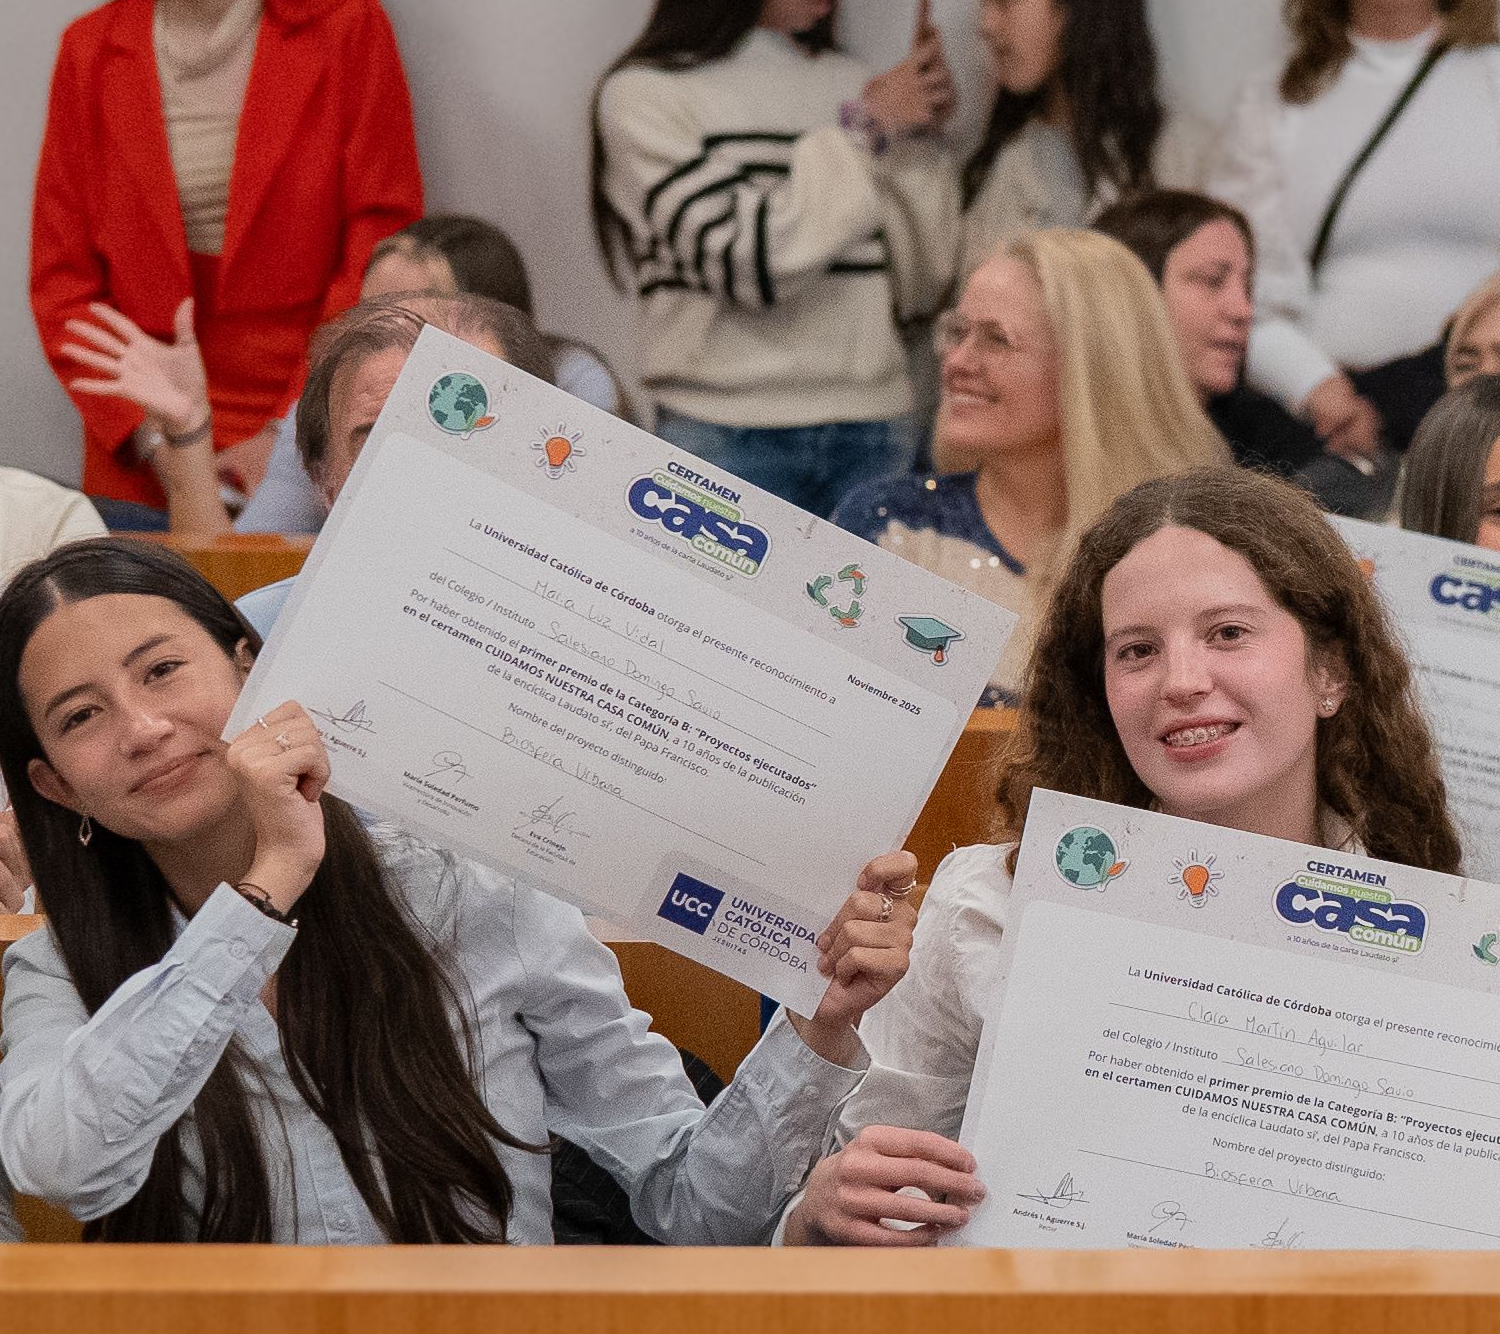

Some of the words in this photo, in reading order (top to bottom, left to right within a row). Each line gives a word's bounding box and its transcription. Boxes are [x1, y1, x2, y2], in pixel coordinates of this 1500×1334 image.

[666, 460, 742, 504] CERTAMEN
[628, 477, 769, 563] casa
[691, 533, 757, 575] común
[467, 517, 483, 531] La
[482, 523, 549, 563] Universidad
[548, 557, 593, 585] Católica
[593, 580, 609, 593] de
[609, 587, 656, 616] Córdoba
[655, 611, 691, 634] otorga
[690, 628, 703, 639] el
[701, 634, 749, 662] presente
[748, 656, 828, 700] reconocimiento
[828, 695, 837, 705] a
[846, 673, 899, 705] Noviembre
[897, 698, 922, 716] 2025
[1306, 859, 1387, 886] CERTAMEN
[668, 887, 713, 920] UCC
[723, 905, 795, 949] CATÓLICA
[729, 894, 822, 947] UNIVERSIDA
[1275, 882, 1426, 939] casa
[716, 920, 738, 939] DE
[737, 929, 811, 973] CÓRDOBA
[1350, 924, 1419, 952] común
[1127, 966, 1141, 978] La
[1143, 968, 1214, 993] Universidad
[1215, 983, 1263, 1003] Católica
[1265, 994, 1281, 1007] de
[1282, 997, 1332, 1017] Córdoba
[1333, 1010, 1371, 1027] otorga
[1372, 1017, 1384, 1028] el
[1385, 1020, 1435, 1039] presente
[1186, 1000, 1231, 1028] Clara
[1306, 1027, 1365, 1063] Aguilar
[1087, 1050, 1107, 1063] Por
[1109, 1054, 1143, 1070] haber
[1143, 1062, 1195, 1081] obtenido
[1196, 1073, 1207, 1084] el
[1208, 1076, 1250, 1093] primer
[1251, 1085, 1294, 1102] premio
[1296, 1094, 1311, 1106] de
[1313, 1097, 1325, 1108] la
[1326, 1099, 1383, 1121] Categoría
[1386, 1112, 1398, 1123] B:
[1101, 1028, 1121, 1040] del
[1121, 1031, 1163, 1050] Colegio
[1171, 1042, 1219, 1061] Instituto
[1309, 1064, 1371, 1100] Domingo
[1084, 1069, 1099, 1078] en
[1101, 1071, 1113, 1081] el
[1114, 1074, 1172, 1093] certamen
[1174, 1085, 1239, 1107] CUIDAMOS
[1240, 1099, 1295, 1118] NUESTRA
[1297, 1111, 1327, 1126] CASA
[1329, 1116, 1378, 1137] COMÚN,
[1382, 1129, 1389, 1138] a
[1391, 1129, 1406, 1141] 10
[1407, 1133, 1434, 1147] años
[1436, 1138, 1451, 1150] de
[1452, 1141, 1463, 1153] la
[1181, 1104, 1196, 1115] de
[1198, 1107, 1209, 1118] la
[1210, 1110, 1257, 1128] encíclica
[1258, 1120, 1305, 1138] Laudato
[1322, 1132, 1341, 1145] del
[1342, 1136, 1370, 1152] Papa
[1372, 1142, 1426, 1163] Francisco.
[1211, 1137, 1256, 1155] Nombre
[1257, 1146, 1275, 1158] del
[1275, 1150, 1323, 1169] proyecto
[1324, 1159, 1386, 1181] distinguido:
